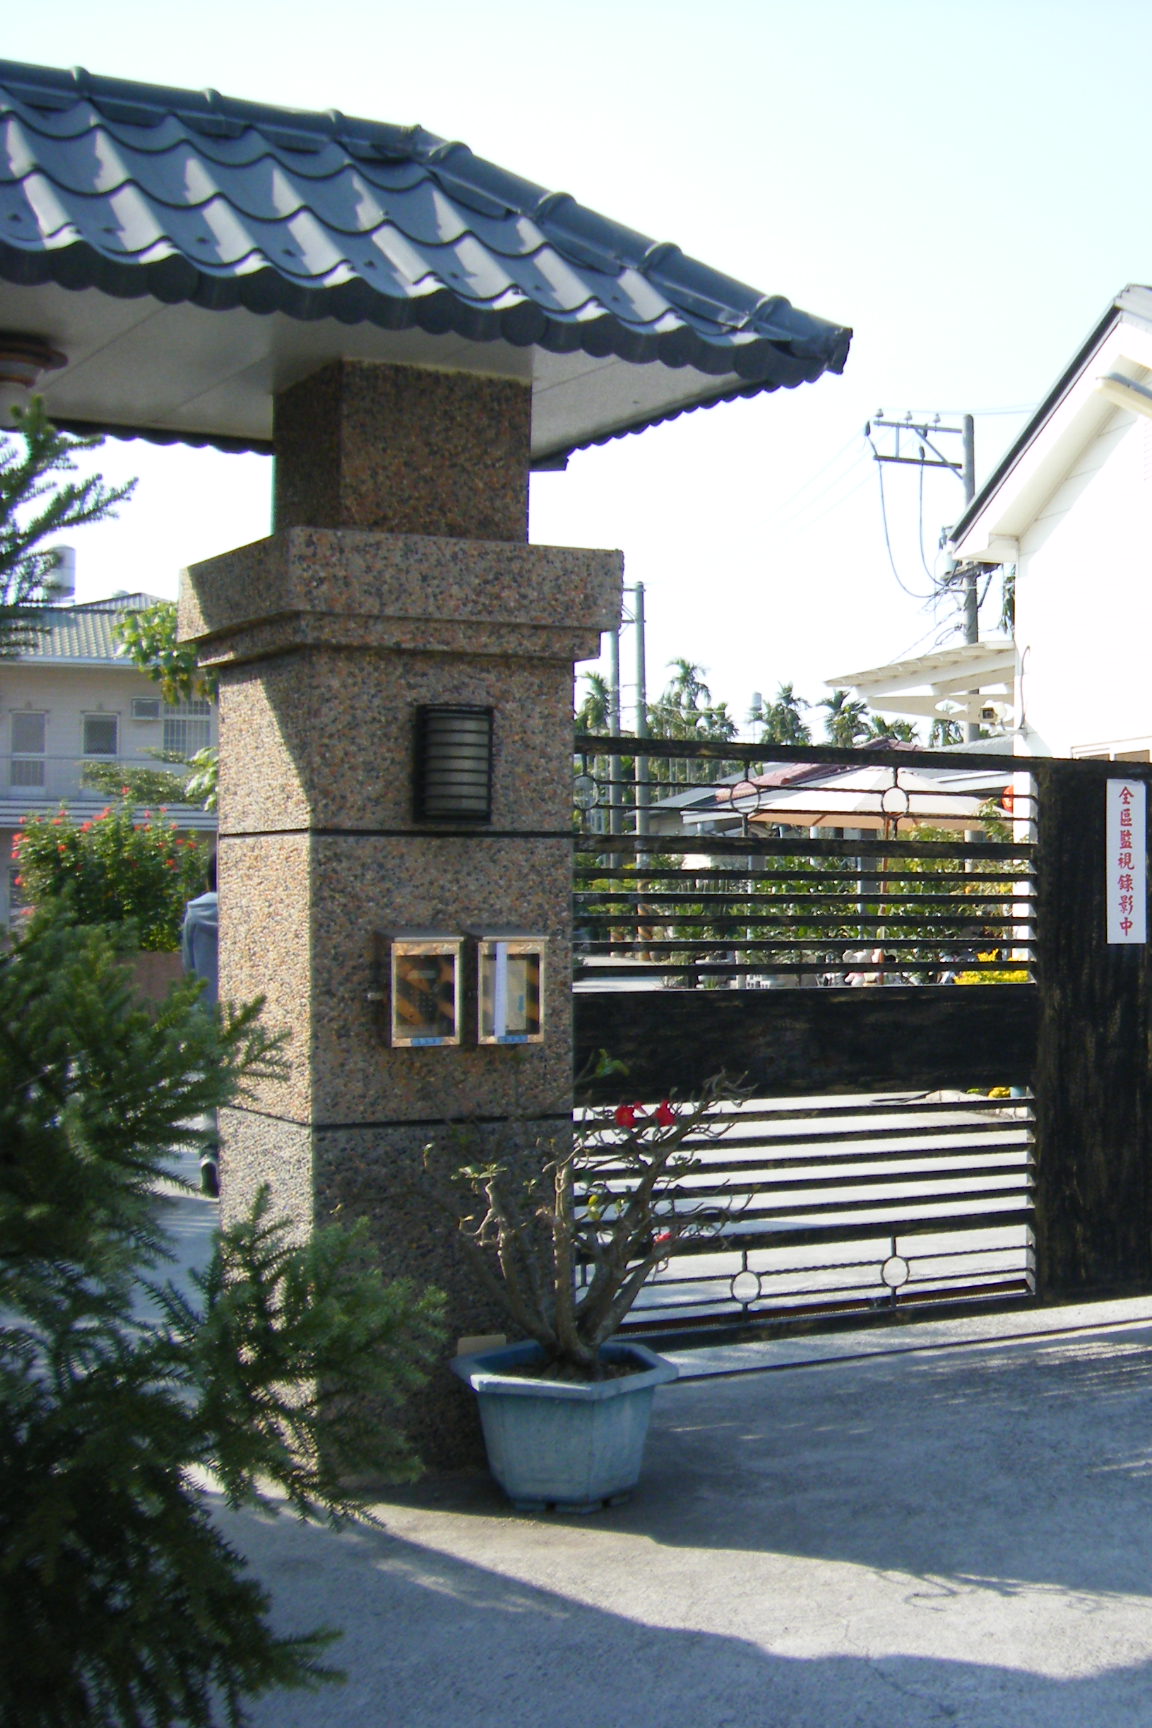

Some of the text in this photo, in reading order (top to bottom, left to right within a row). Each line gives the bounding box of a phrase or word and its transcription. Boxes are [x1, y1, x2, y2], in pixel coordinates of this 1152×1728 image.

[1118, 786, 1135, 936] 全區監視錄影中
